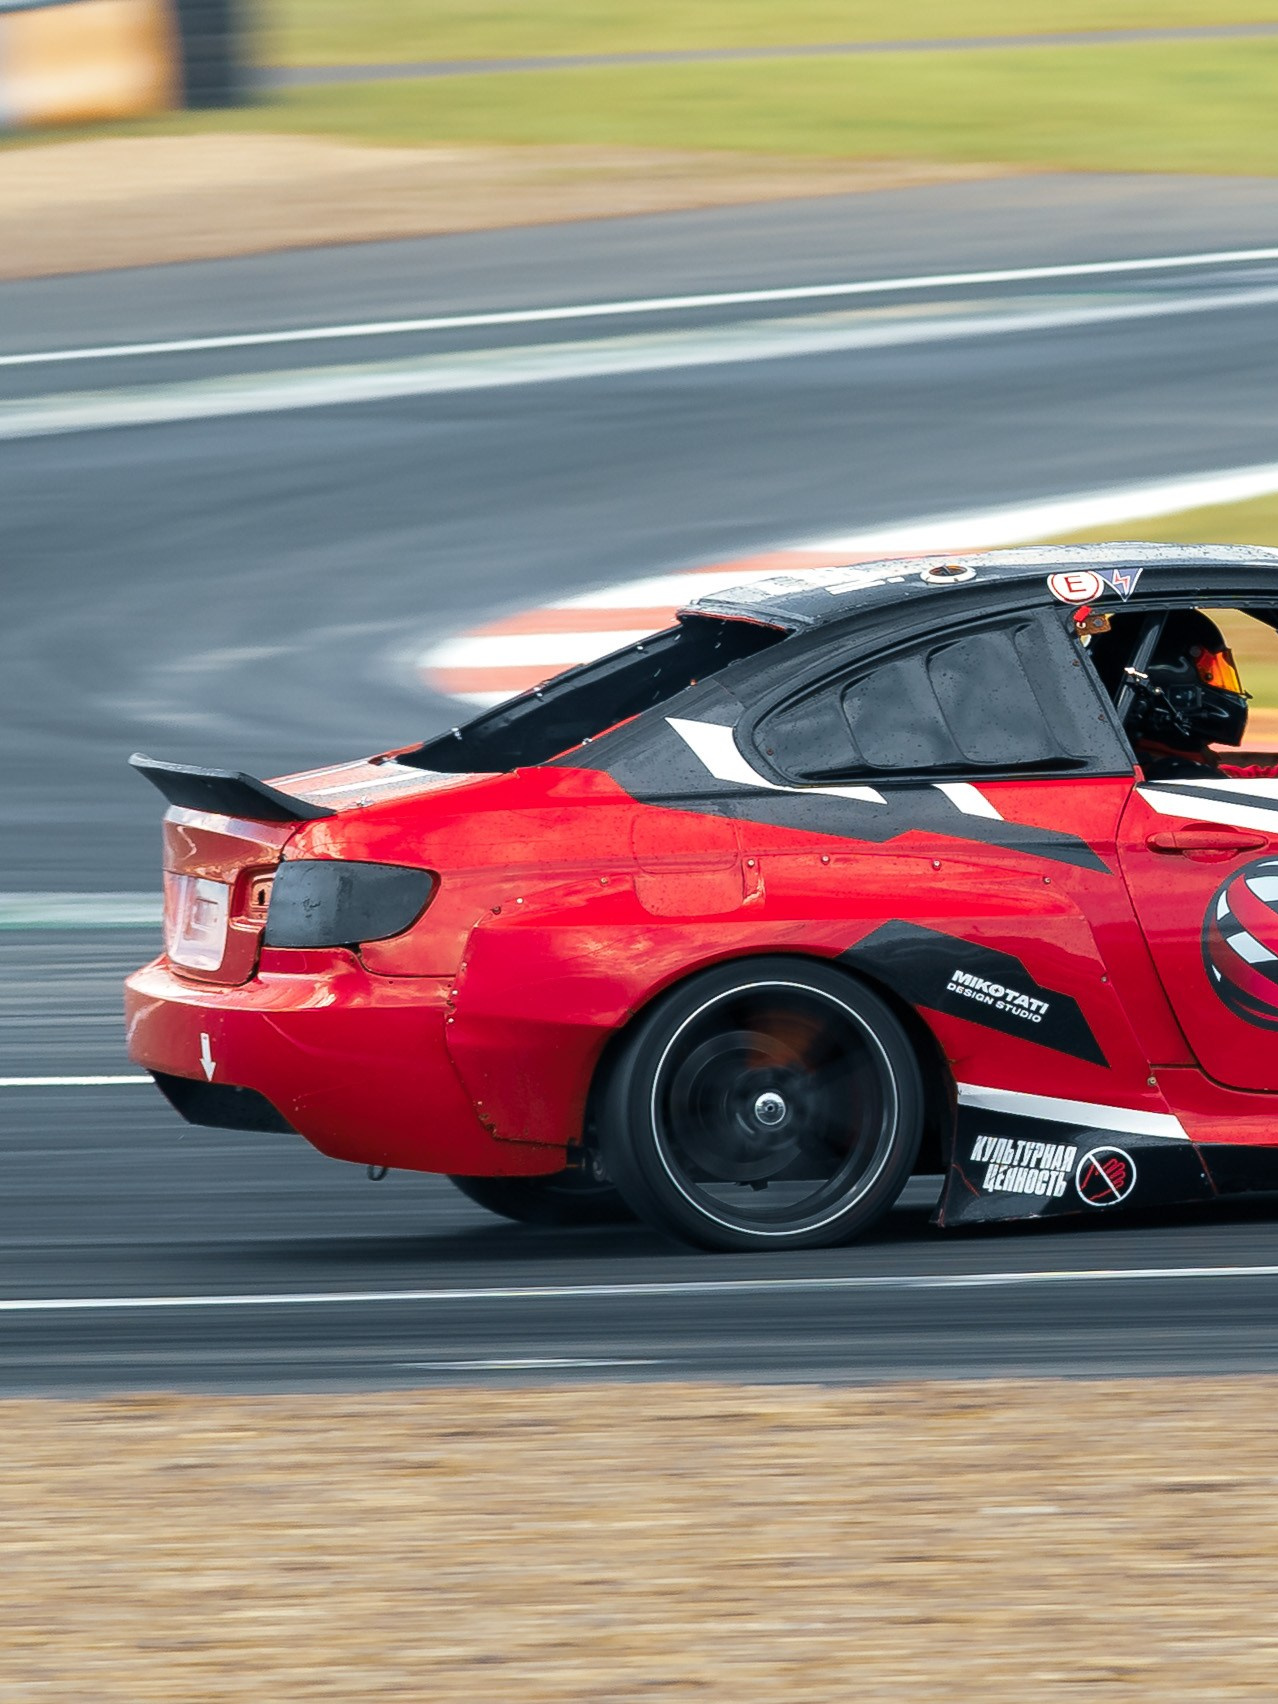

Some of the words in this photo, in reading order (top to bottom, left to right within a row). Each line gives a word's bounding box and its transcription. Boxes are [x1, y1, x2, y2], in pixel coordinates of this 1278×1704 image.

[1064, 575, 1087, 593] E
[946, 982, 995, 1005] DESIGN
[995, 1001, 1042, 1023] STUDIO
[951, 970, 1050, 1015] MIKOTATI
[970, 1135, 1078, 1172] КУЛЬТУРНАЯ
[982, 1163, 1067, 1197] ЦЕННОСТЬ
